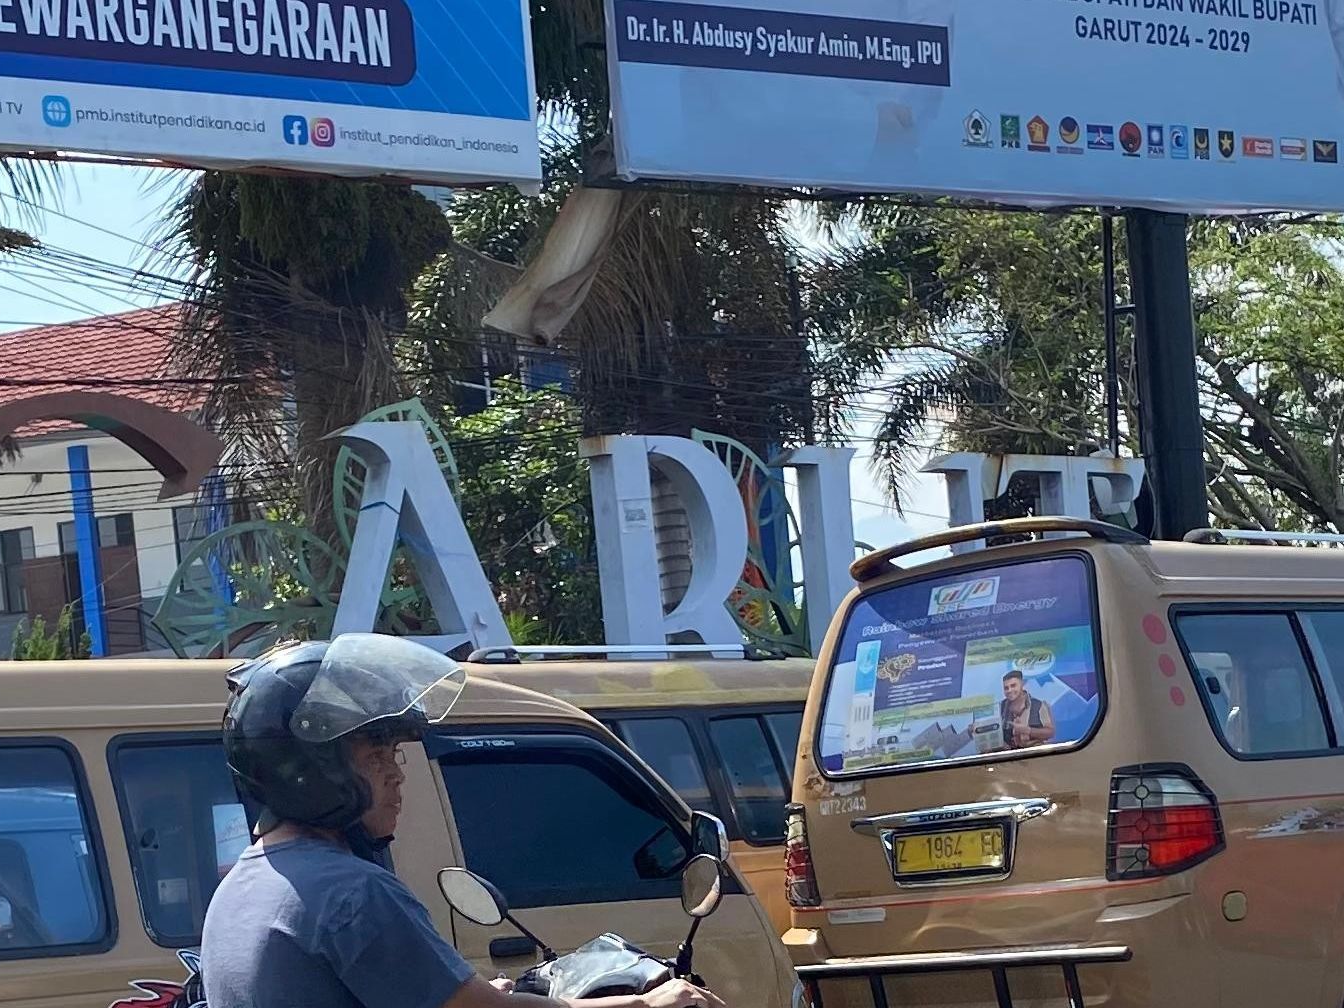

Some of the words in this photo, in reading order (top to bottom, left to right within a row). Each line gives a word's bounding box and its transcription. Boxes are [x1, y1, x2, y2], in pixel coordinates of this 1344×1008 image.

[1190, 0, 1249, 18] WAKIL
[1254, 1, 1317, 25] BUPATI
[626, 16, 650, 42] Dr.
[653, 19, 670, 43] Ir.
[673, 21, 689, 45] H.
[692, 22, 752, 55] Abdusy
[756, 27, 813, 58] Syakur
[818, 32, 863, 61] Amin,
[865, 36, 915, 69] M.Eng.
[918, 39, 943, 66] IPU
[1075, 15, 1141, 42] GARUT
[1146, 23, 1189, 47] 2024
[1208, 29, 1250, 52] 2029
[6, 101, 23, 115] TV
[75, 107, 265, 134] pmb.institutpendidikan.ac.id
[339, 128, 519, 154] institut_pendidikan_indonesia
[1001, 140, 1020, 149] PKB
[896, 839, 907, 863] Z
